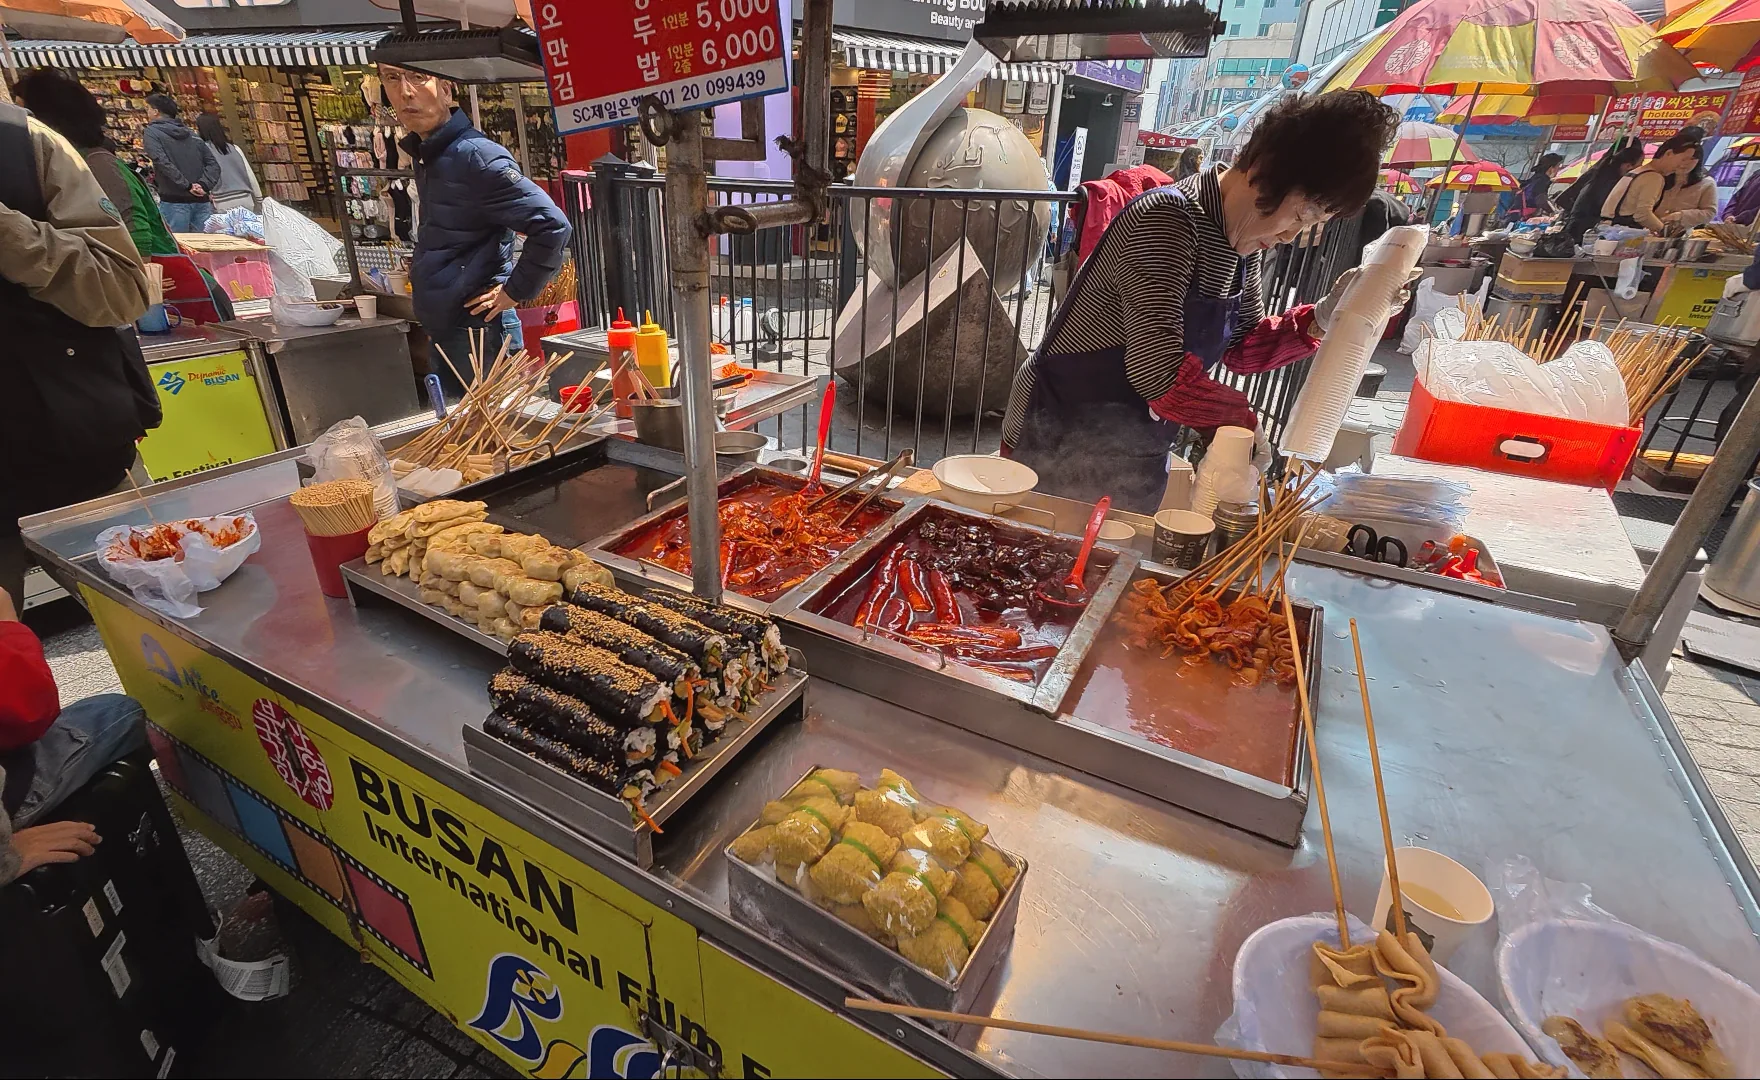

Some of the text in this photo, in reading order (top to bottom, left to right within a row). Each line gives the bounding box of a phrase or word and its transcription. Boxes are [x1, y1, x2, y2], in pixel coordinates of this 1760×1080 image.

[541, 3, 563, 30] 오
[696, 0, 770, 32] 5,000
[930, 11, 964, 31] Beauty
[546, 11, 689, 68] 만 두 1인분
[552, 25, 775, 101] 김 밥 1인분 6,000
[673, 58, 692, 74] 2줄
[651, 88, 675, 105] 01
[681, 83, 700, 102] 20
[705, 69, 766, 96] 099439
[1647, 110, 1690, 119] hotteok
[188, 370, 226, 383] Dynamic
[204, 373, 240, 386] BUSAN
[348, 757, 579, 936] BUSAN
[363, 810, 604, 990] International
